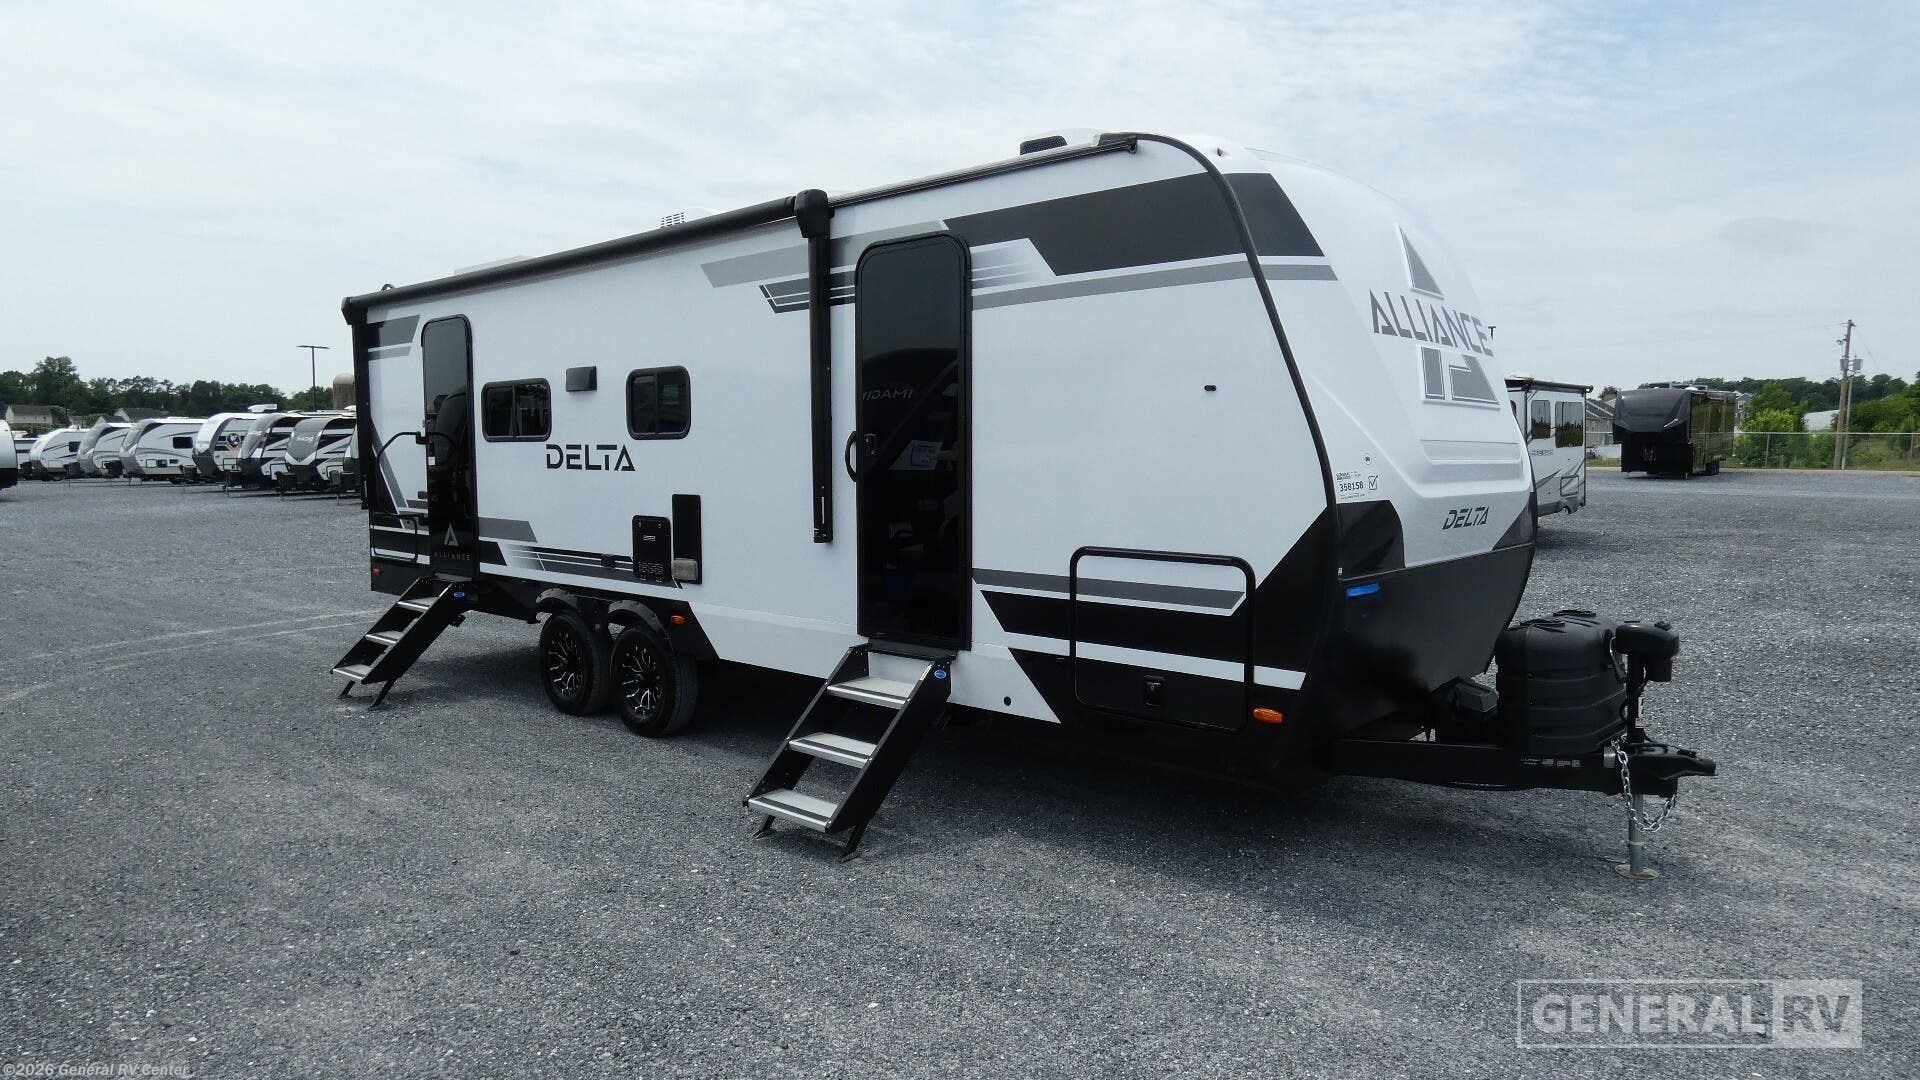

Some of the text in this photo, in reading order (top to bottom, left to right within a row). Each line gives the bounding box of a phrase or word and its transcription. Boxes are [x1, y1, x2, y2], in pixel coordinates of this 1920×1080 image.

[1369, 289, 1494, 357] ALLIANCE
[546, 444, 636, 471] DELTA
[1339, 480, 1364, 492] 358158
[1442, 506, 1489, 530] DELTA
